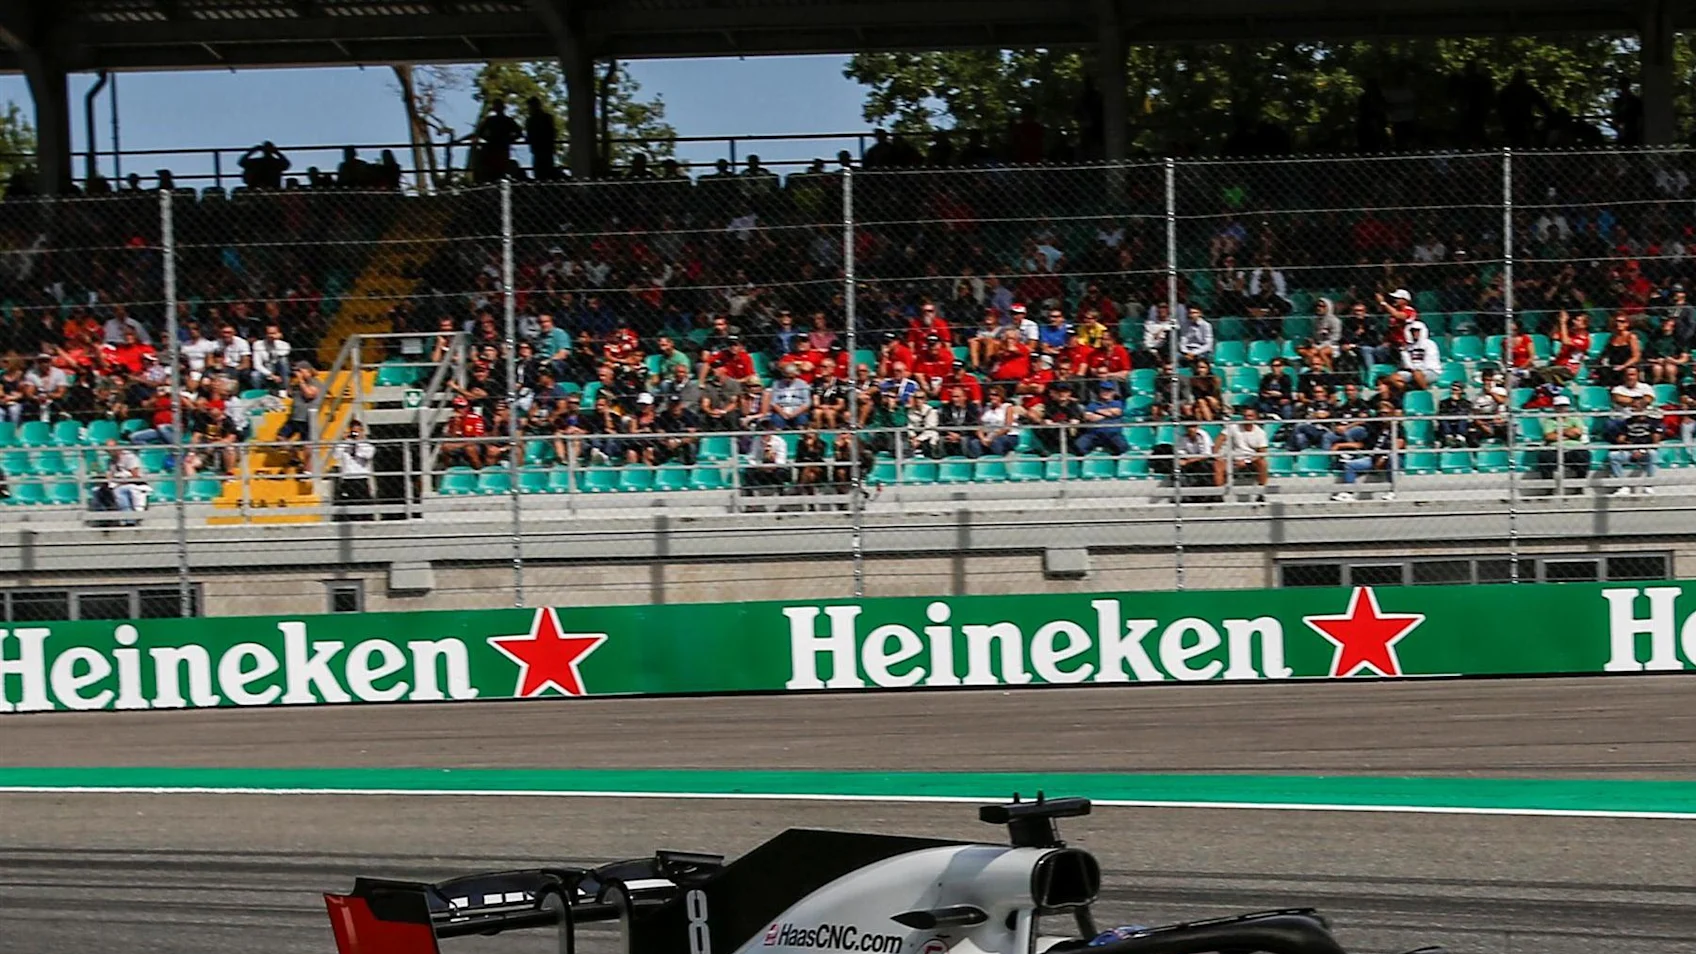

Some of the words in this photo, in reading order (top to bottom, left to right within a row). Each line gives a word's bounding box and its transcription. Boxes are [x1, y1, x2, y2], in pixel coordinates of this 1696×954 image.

[0, 622, 479, 712] Heineken
[783, 600, 1293, 690] Heineken
[778, 924, 903, 954] HaasCNC.com
